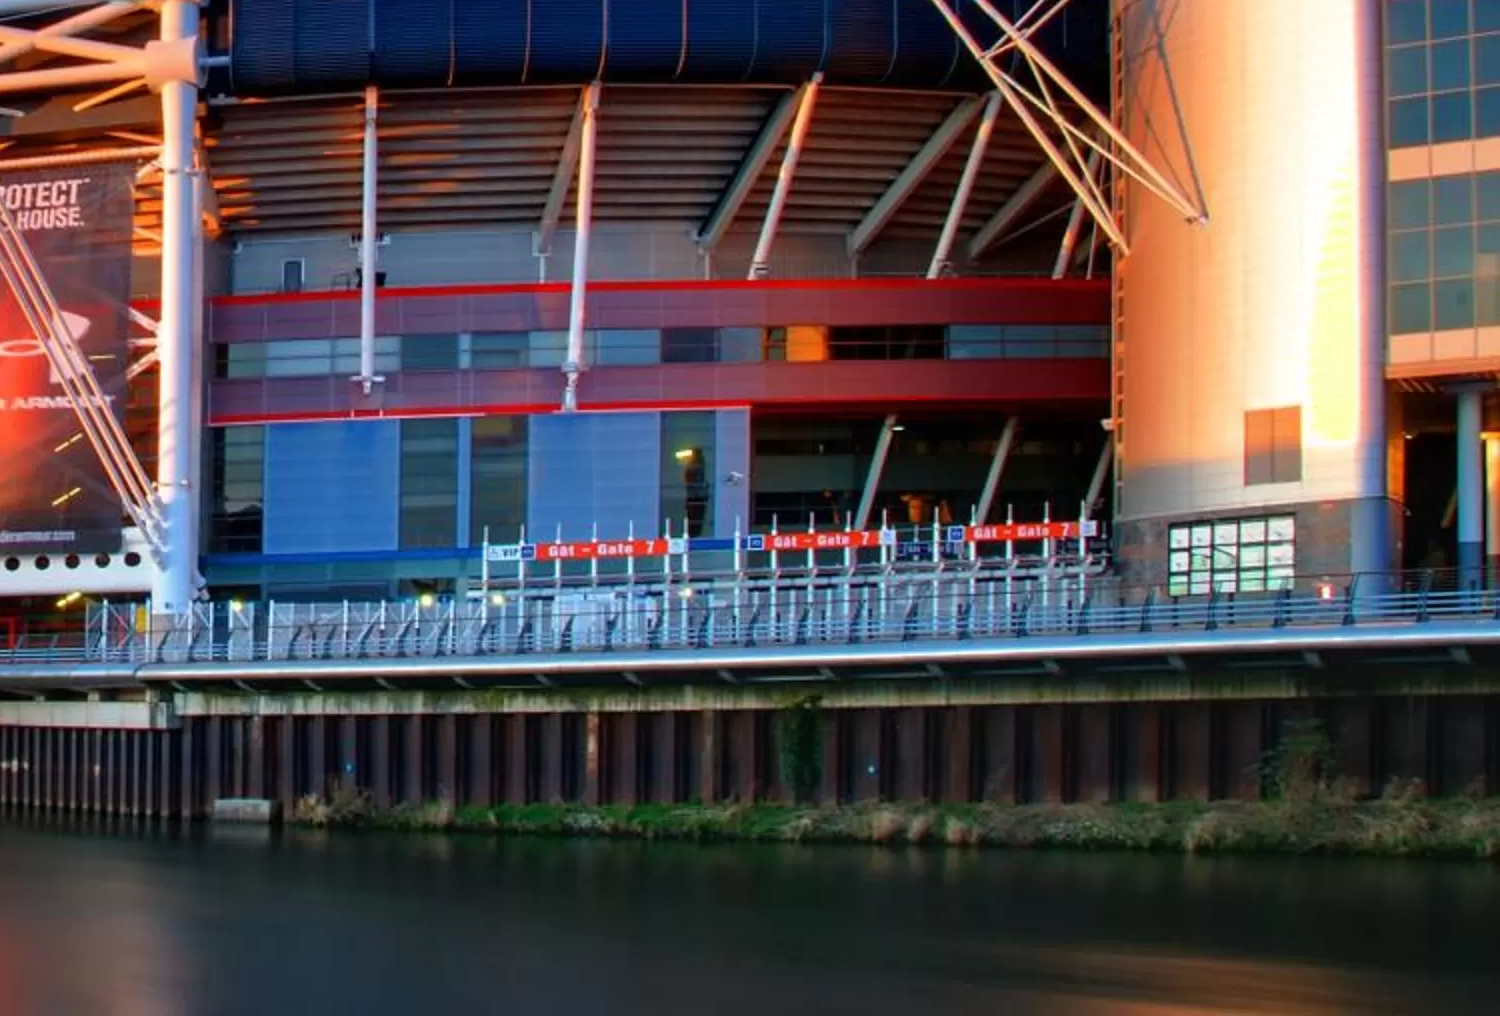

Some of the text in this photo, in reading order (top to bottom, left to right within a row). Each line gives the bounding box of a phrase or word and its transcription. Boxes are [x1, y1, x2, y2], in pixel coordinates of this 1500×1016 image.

[1017, 525, 1049, 537] Gate
[817, 534, 850, 546] Gate
[597, 543, 633, 555] Gate
